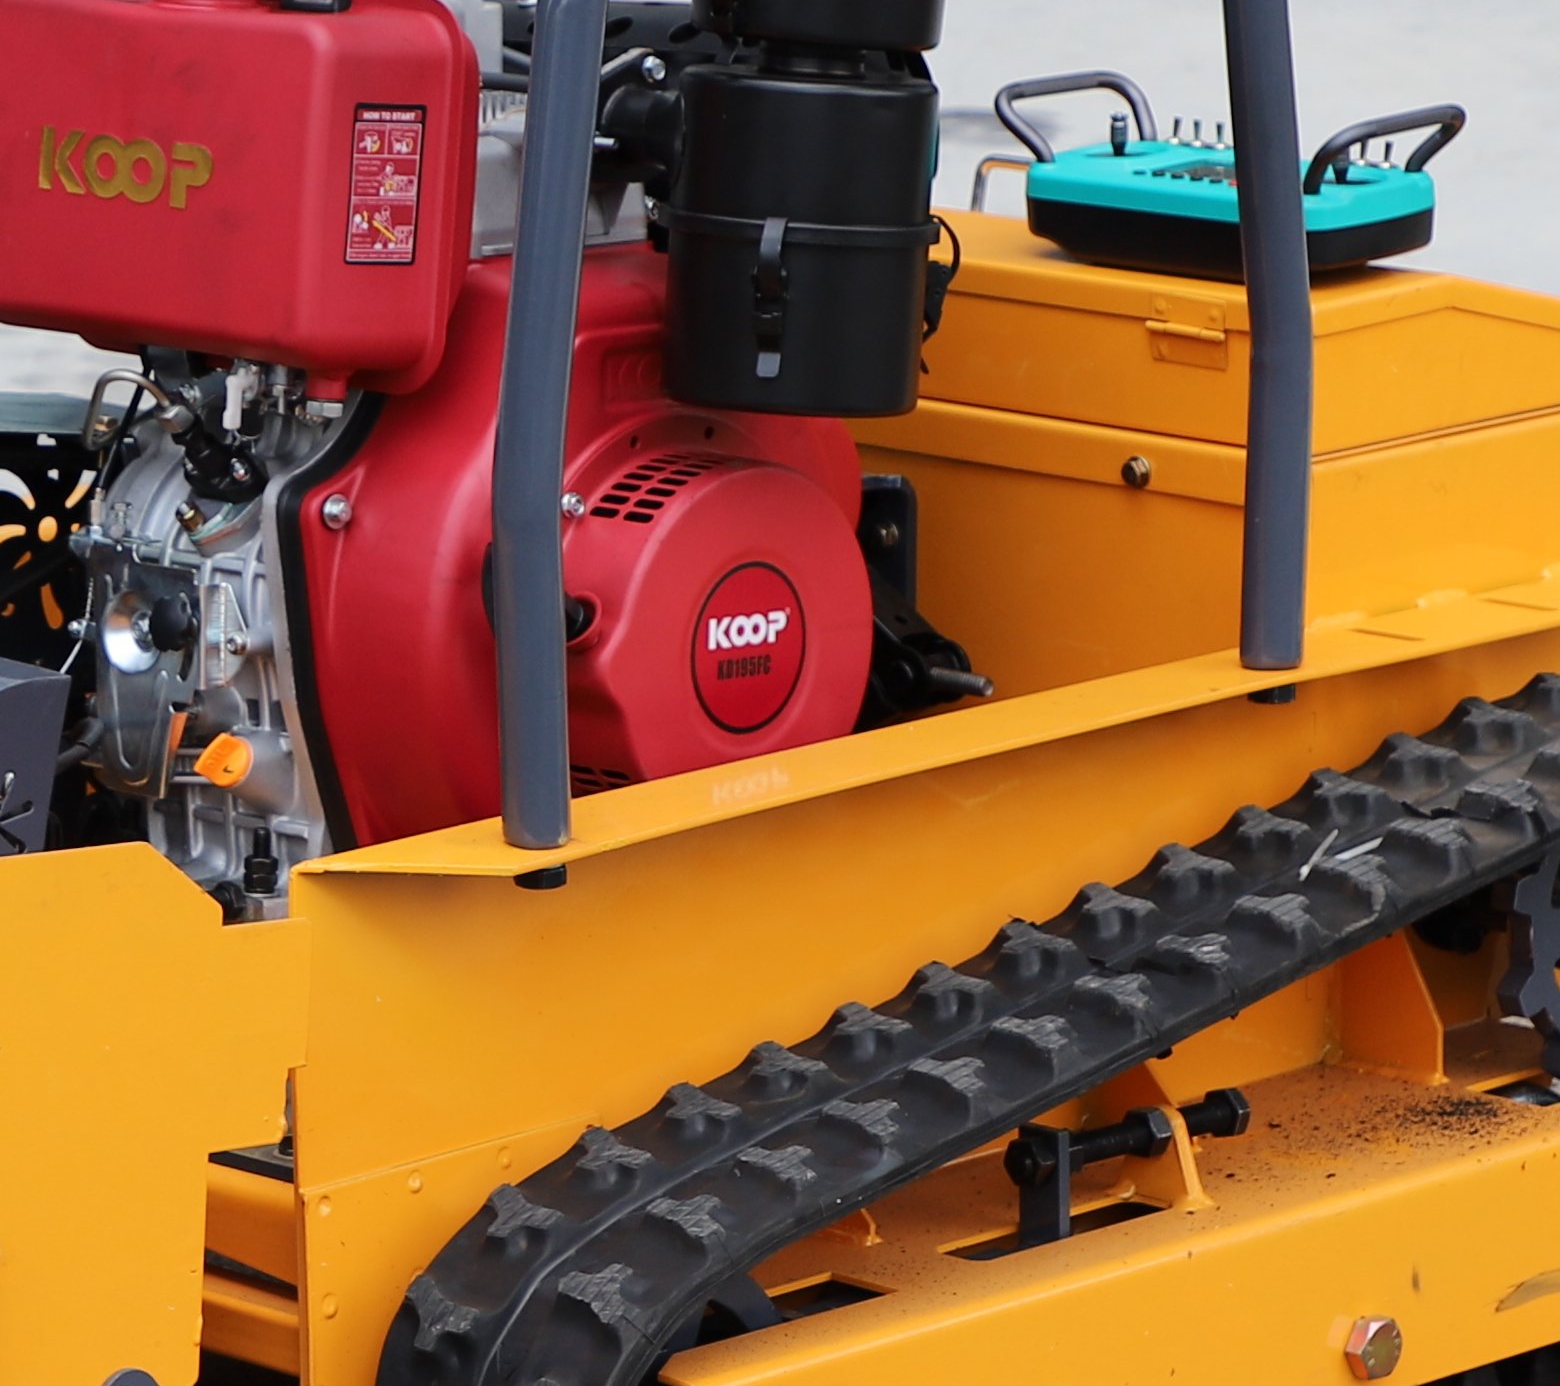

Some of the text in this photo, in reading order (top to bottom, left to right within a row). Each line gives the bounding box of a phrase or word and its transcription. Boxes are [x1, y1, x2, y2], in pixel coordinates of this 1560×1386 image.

[363, 111, 415, 121] HOW TO START
[38, 125, 214, 209] KOOP
[708, 610, 788, 651] KOOP
